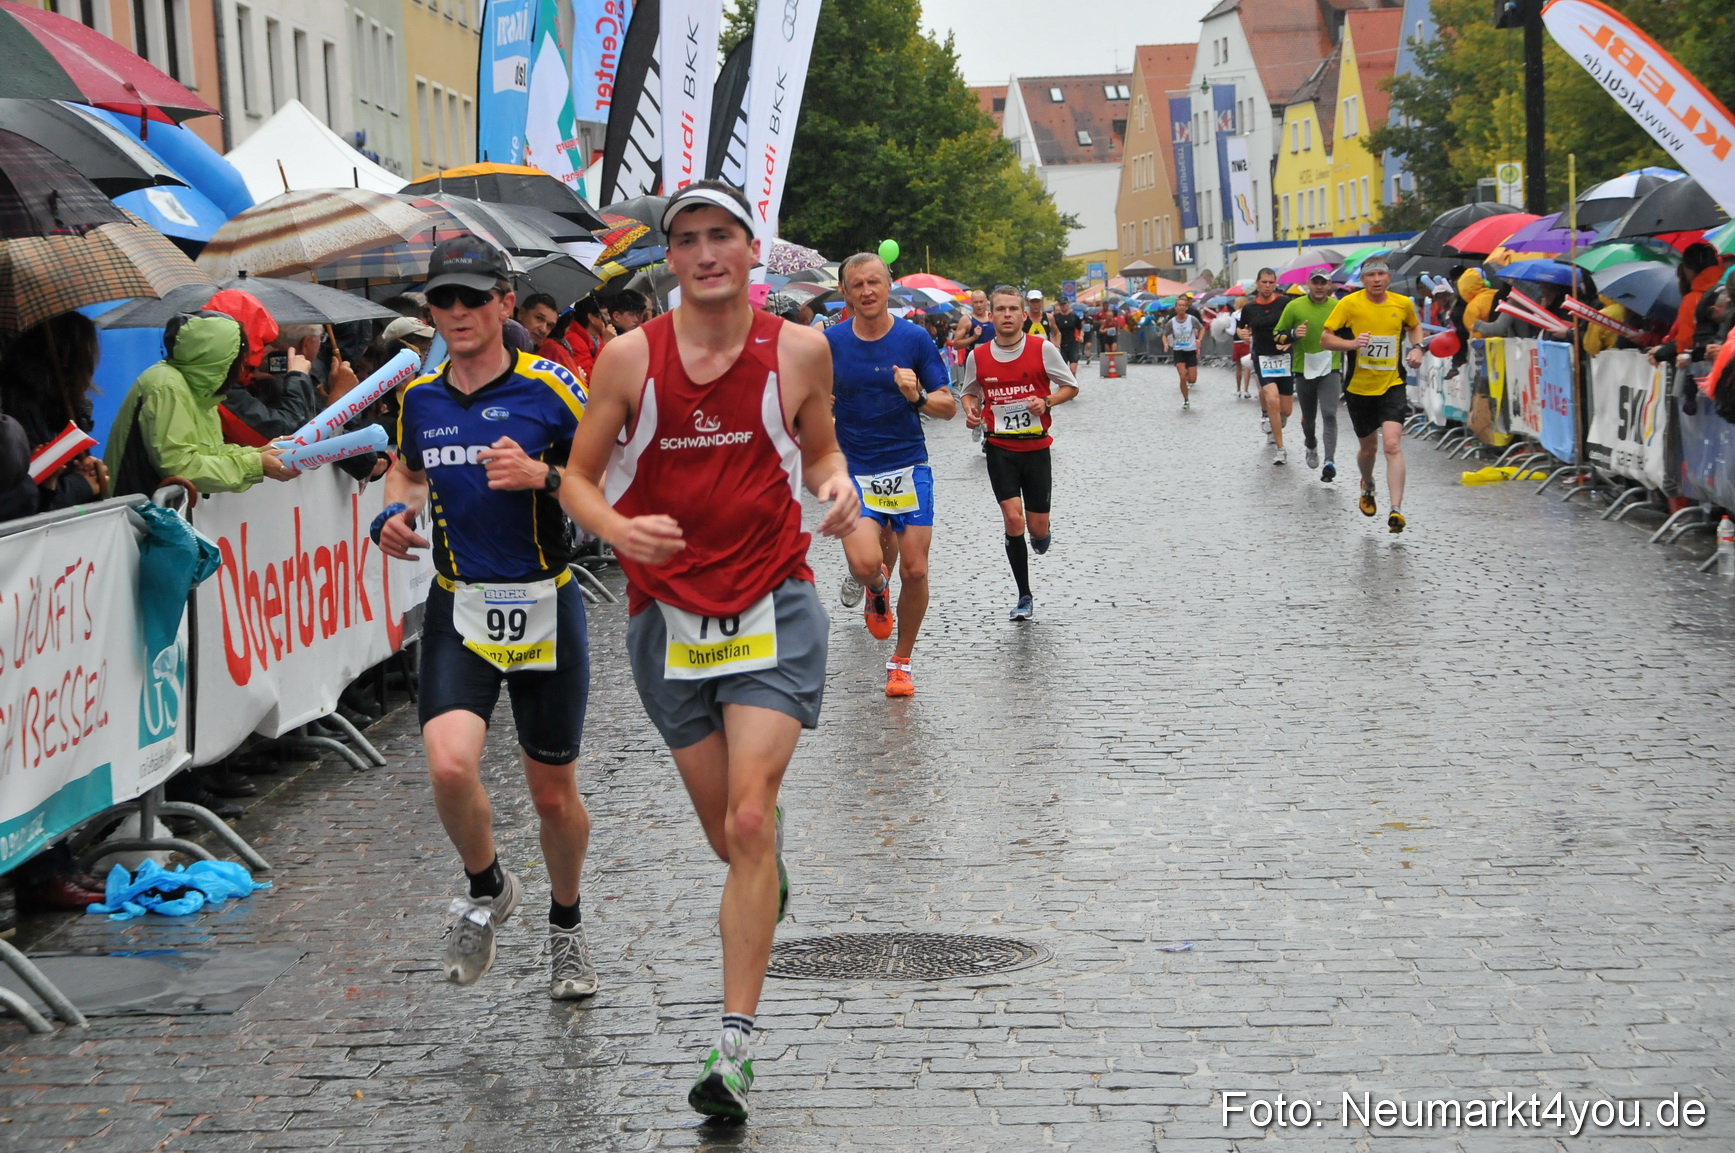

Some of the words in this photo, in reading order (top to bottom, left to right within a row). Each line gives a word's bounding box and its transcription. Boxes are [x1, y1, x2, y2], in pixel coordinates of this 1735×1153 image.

[683, 14, 699, 100] BKK
[757, 143, 777, 224] Audi
[769, 66, 788, 135] BKK
[1367, 344, 1390, 357] 271
[326, 410, 349, 431] TUI
[348, 362, 416, 416] ReiseCenter
[987, 384, 1035, 398] HALUPKA
[1003, 412, 1031, 430] 213
[422, 425, 459, 440] TEAM
[659, 431, 753, 450] SCHWANDORF
[870, 475, 904, 497] 632
[878, 498, 899, 508] Frank
[217, 493, 374, 687] Oberbank
[484, 588, 528, 600] BOCK
[486, 608, 528, 642] 99
[506, 648, 542, 664] Xaver
[688, 643, 751, 665] Christian
